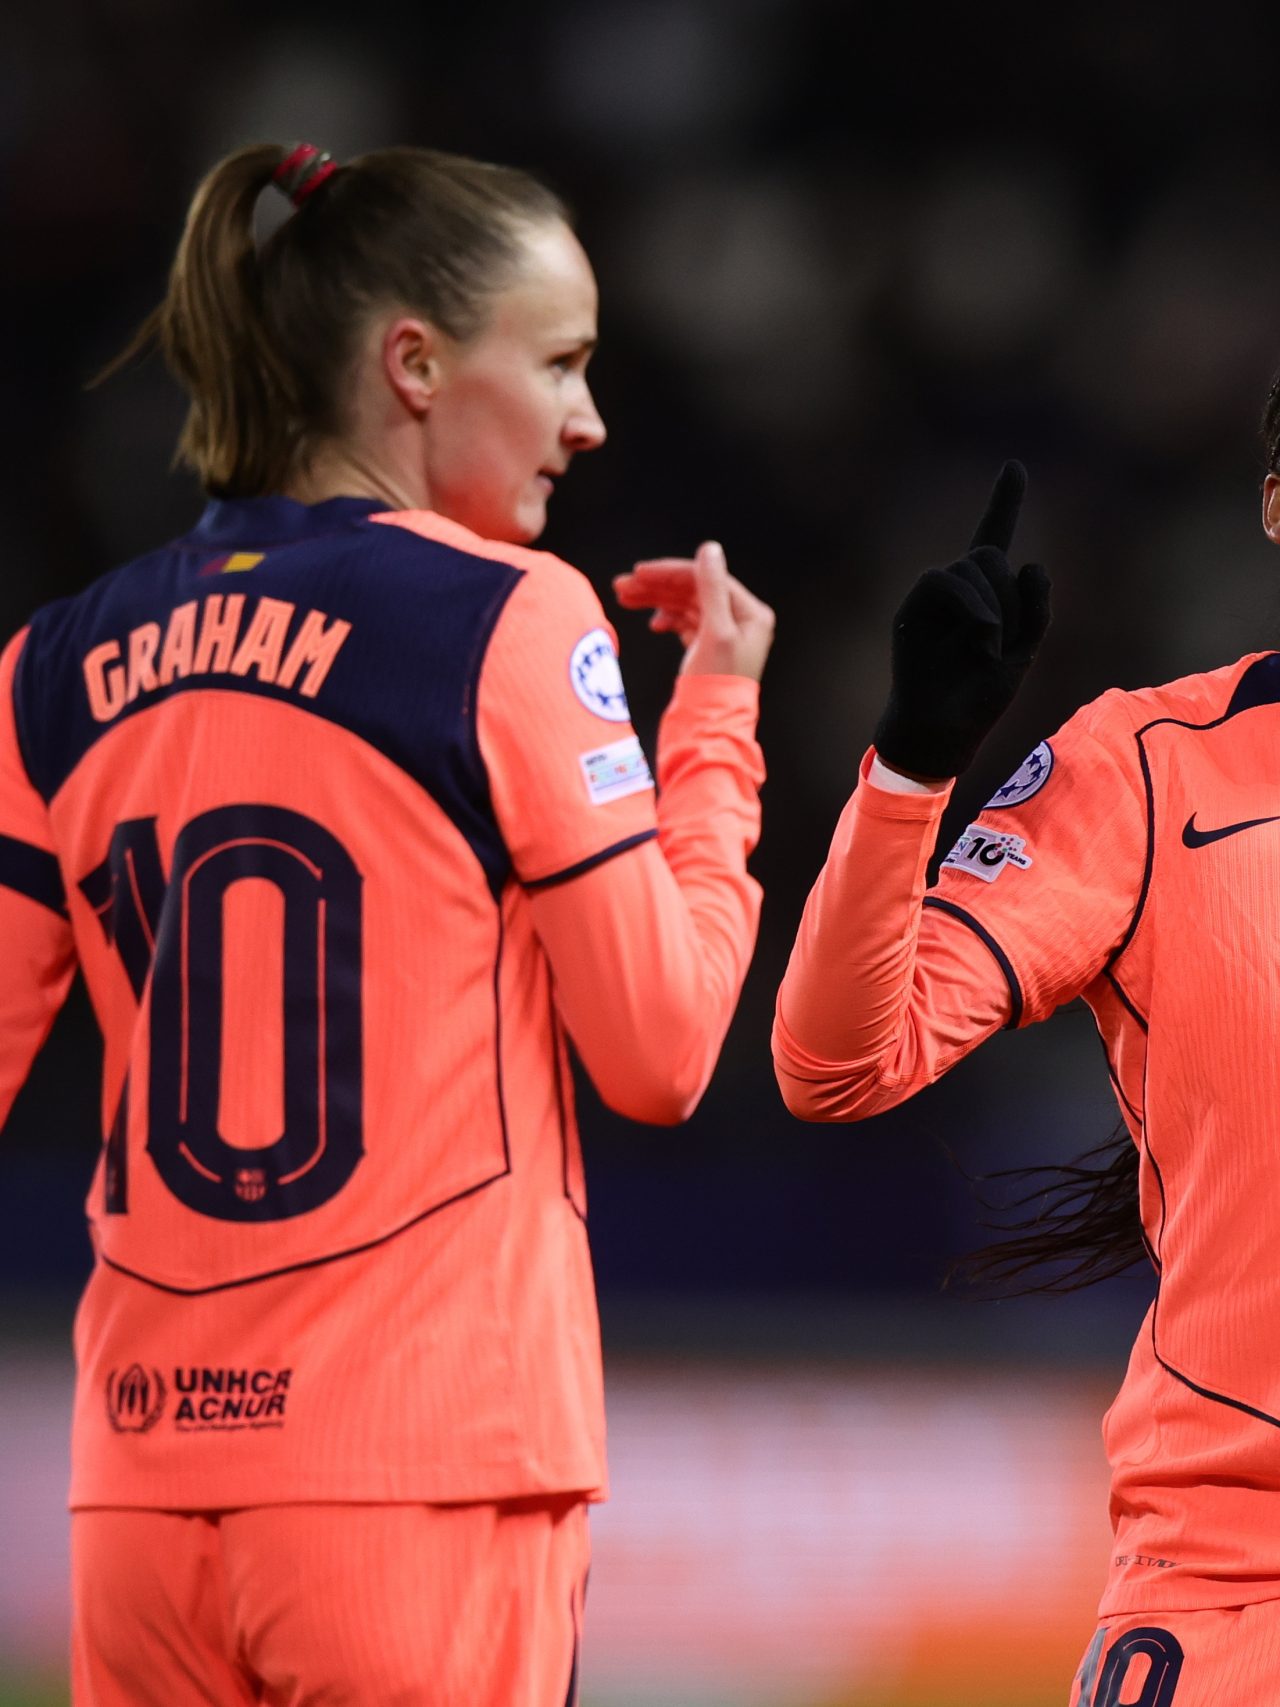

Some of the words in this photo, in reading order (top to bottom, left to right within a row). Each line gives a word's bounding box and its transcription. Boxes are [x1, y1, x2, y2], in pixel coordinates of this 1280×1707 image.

[82, 593, 353, 723] GRAHAM
[966, 836, 1006, 866] 10
[1006, 851, 1028, 866] YEARS
[77, 803, 366, 1224] 10
[175, 1367, 293, 1395] UNHCR
[175, 1393, 286, 1421] ACNUR
